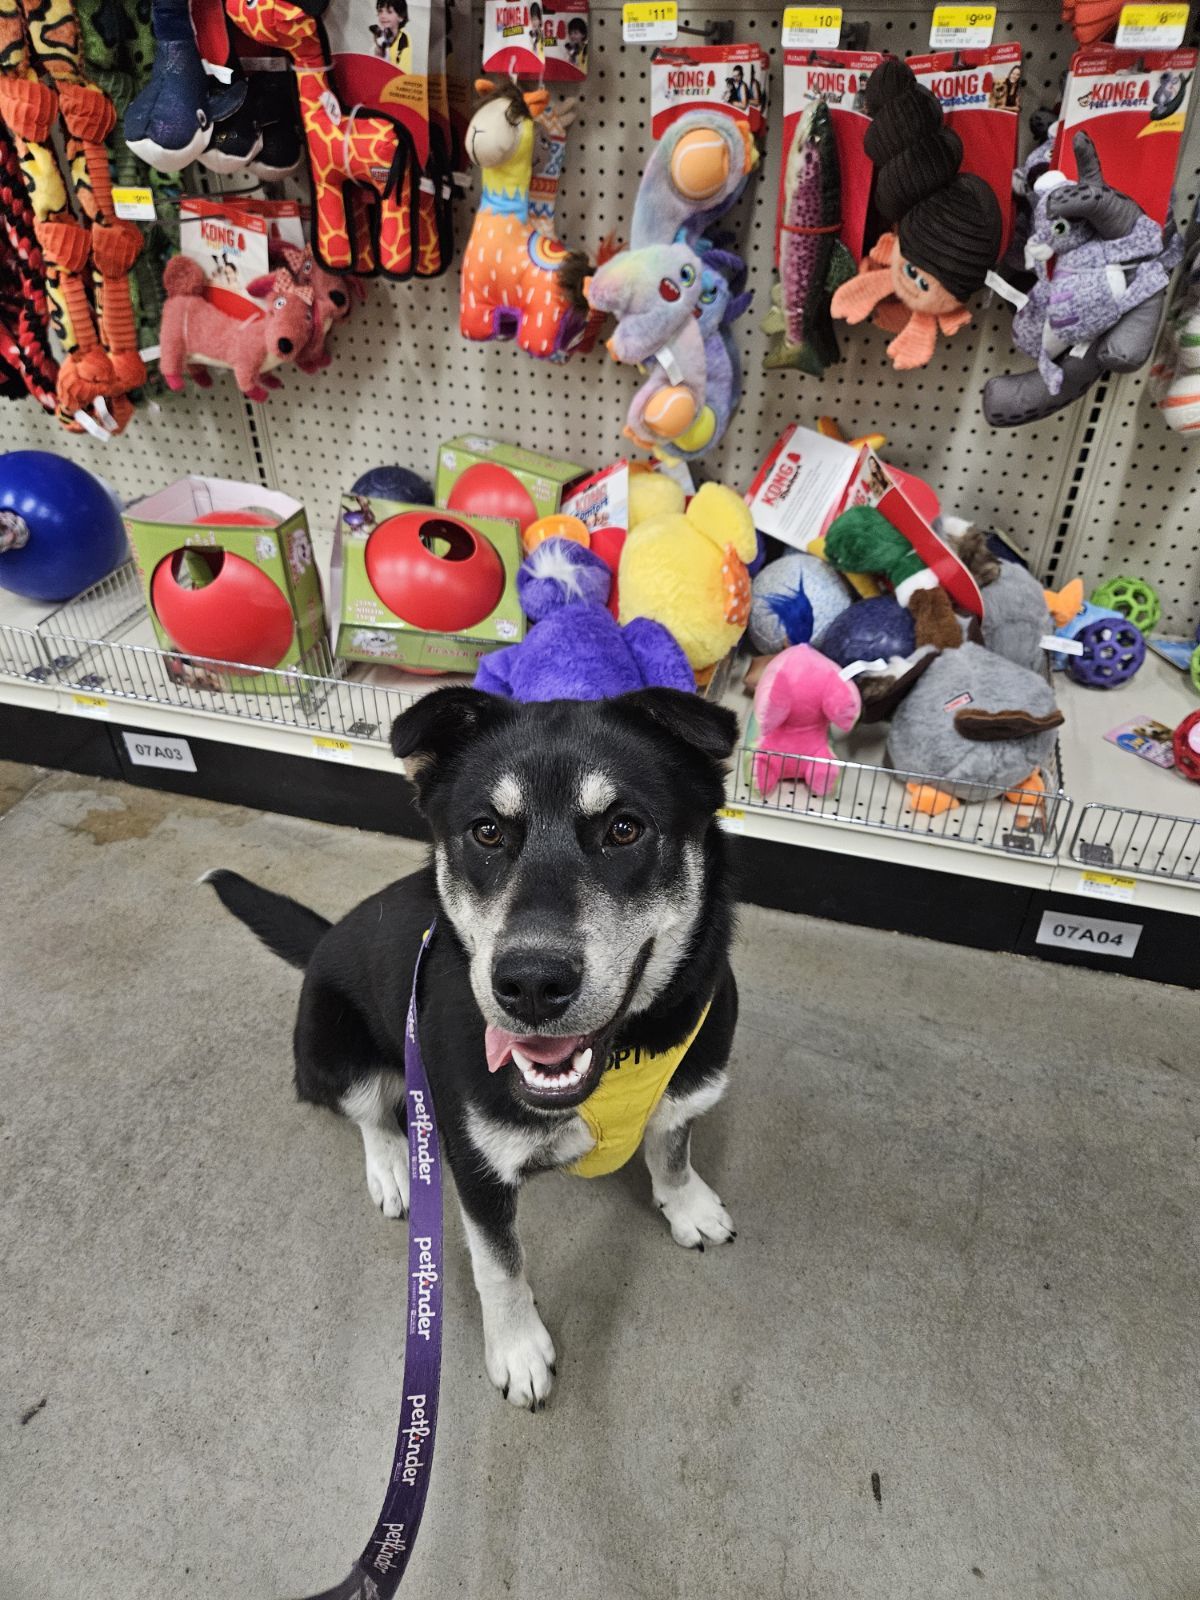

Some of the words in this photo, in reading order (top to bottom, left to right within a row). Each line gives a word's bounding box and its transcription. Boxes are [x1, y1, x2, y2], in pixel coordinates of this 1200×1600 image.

[668, 70, 704, 88] KONG
[807, 71, 845, 93] KONG
[931, 74, 979, 99] KONG
[1092, 81, 1137, 101] KONG
[201, 220, 234, 248] KONG
[762, 463, 793, 507] KONG
[135, 743, 183, 761] 07A03
[1053, 924, 1124, 946] 07A04
[409, 1090, 434, 1185] petfinder
[412, 1237, 438, 1340] petfinder
[402, 1394, 430, 1486] petfinder
